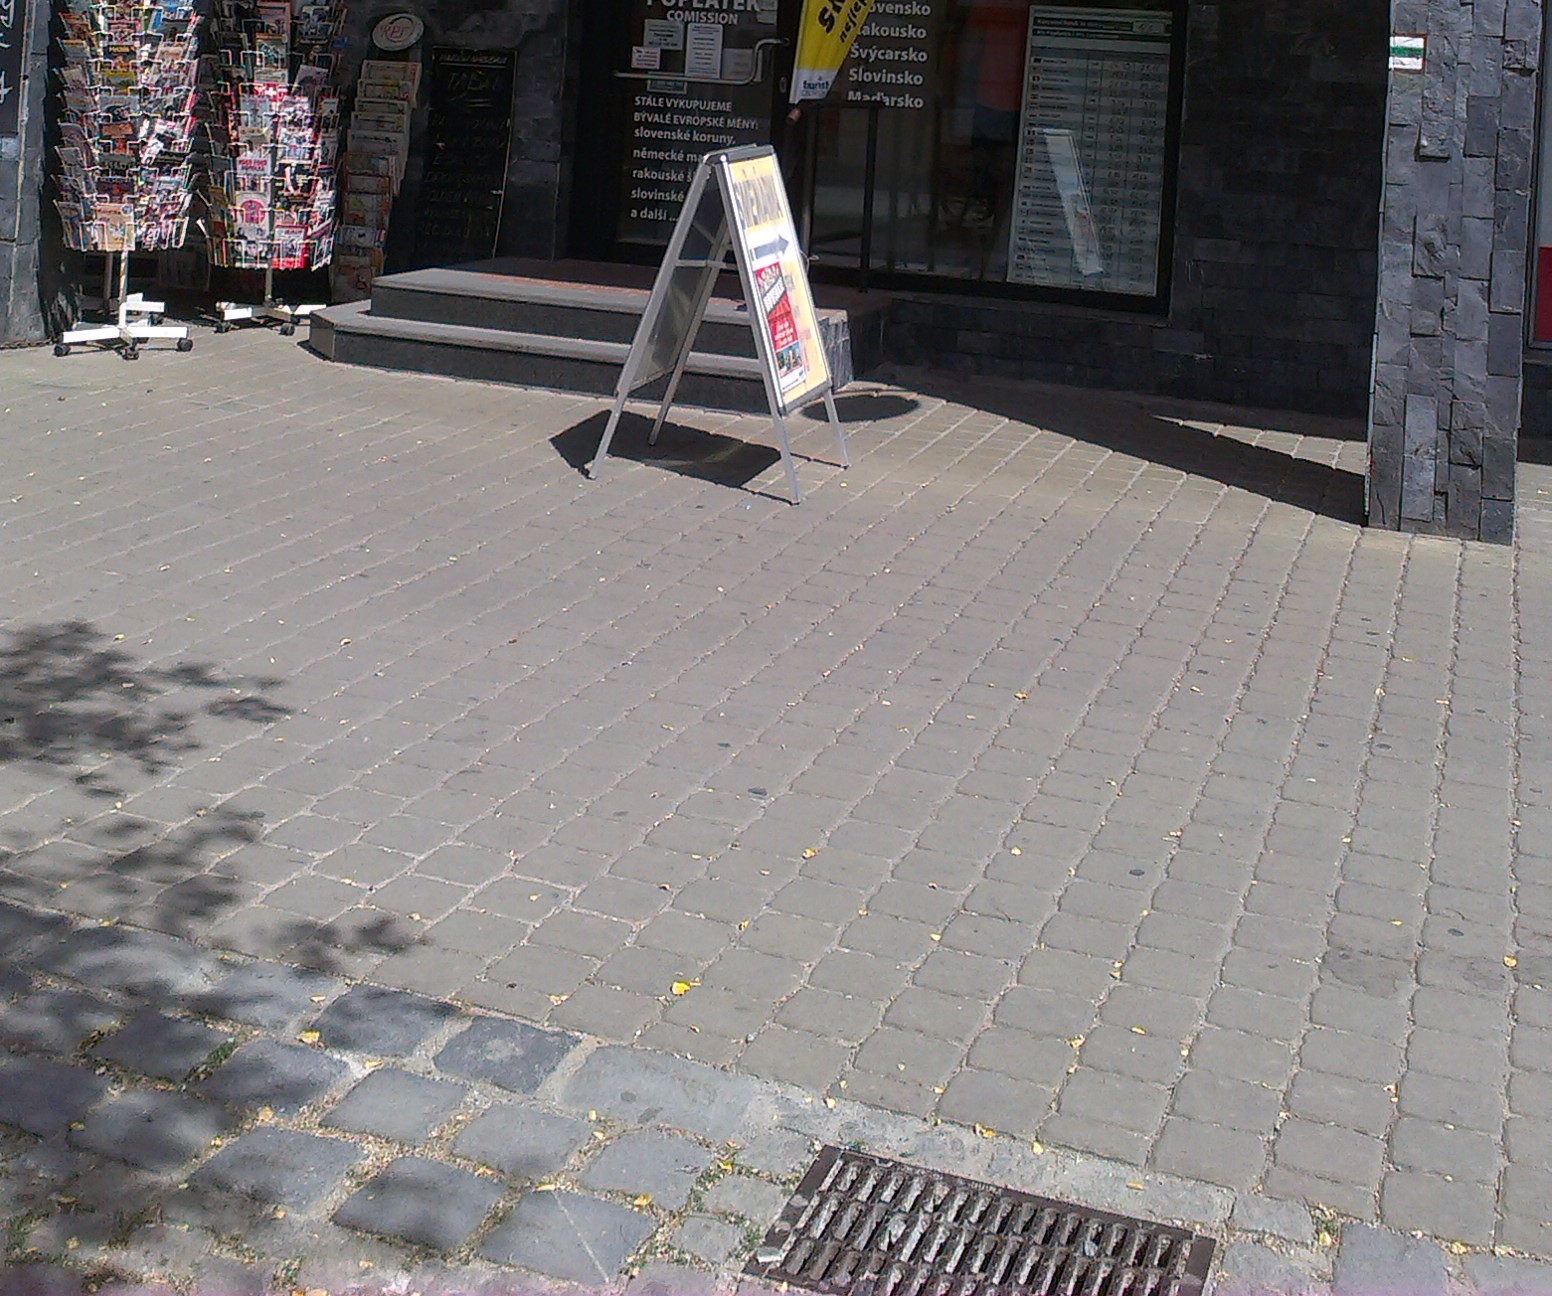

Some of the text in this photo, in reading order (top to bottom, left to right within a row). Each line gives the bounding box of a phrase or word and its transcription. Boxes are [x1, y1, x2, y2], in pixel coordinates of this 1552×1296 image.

[869, 1, 931, 16] ovensko
[666, 10, 738, 25] COMISSION
[850, 43, 928, 63] Švýcarsko
[848, 68, 923, 85] Slovinsko
[634, 95, 733, 112] STÁLE VYKUPUJEME
[633, 126, 691, 141] slovenské
[632, 145, 684, 161] německé
[631, 167, 685, 182] rakouské
[630, 187, 685, 202] slovinské
[630, 209, 638, 218] a
[640, 207, 667, 221] další
